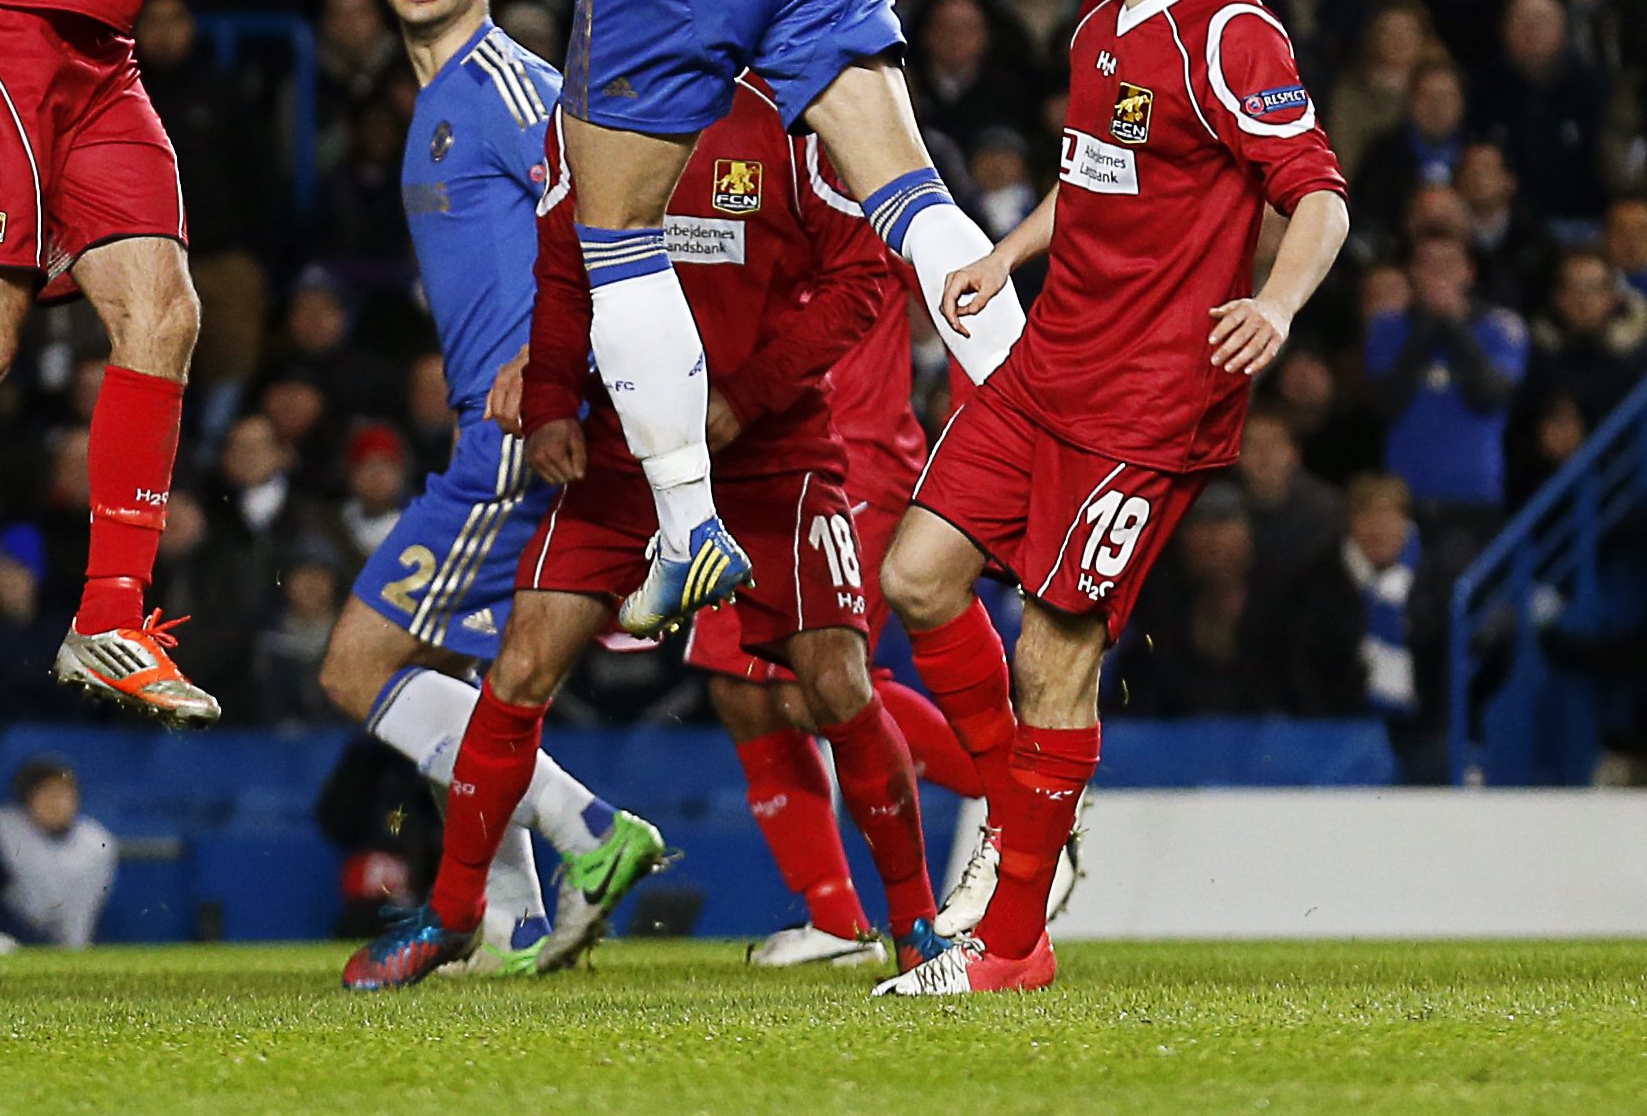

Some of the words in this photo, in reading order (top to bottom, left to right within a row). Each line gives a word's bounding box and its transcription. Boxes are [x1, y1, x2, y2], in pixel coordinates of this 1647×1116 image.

[1263, 89, 1306, 106] RESPECT
[1112, 119, 1146, 138] FCN
[716, 194, 758, 206] FCN
[667, 240, 728, 255] andsbank
[1080, 489, 1150, 578] 19
[808, 513, 862, 588] 18
[380, 544, 437, 614] 2
